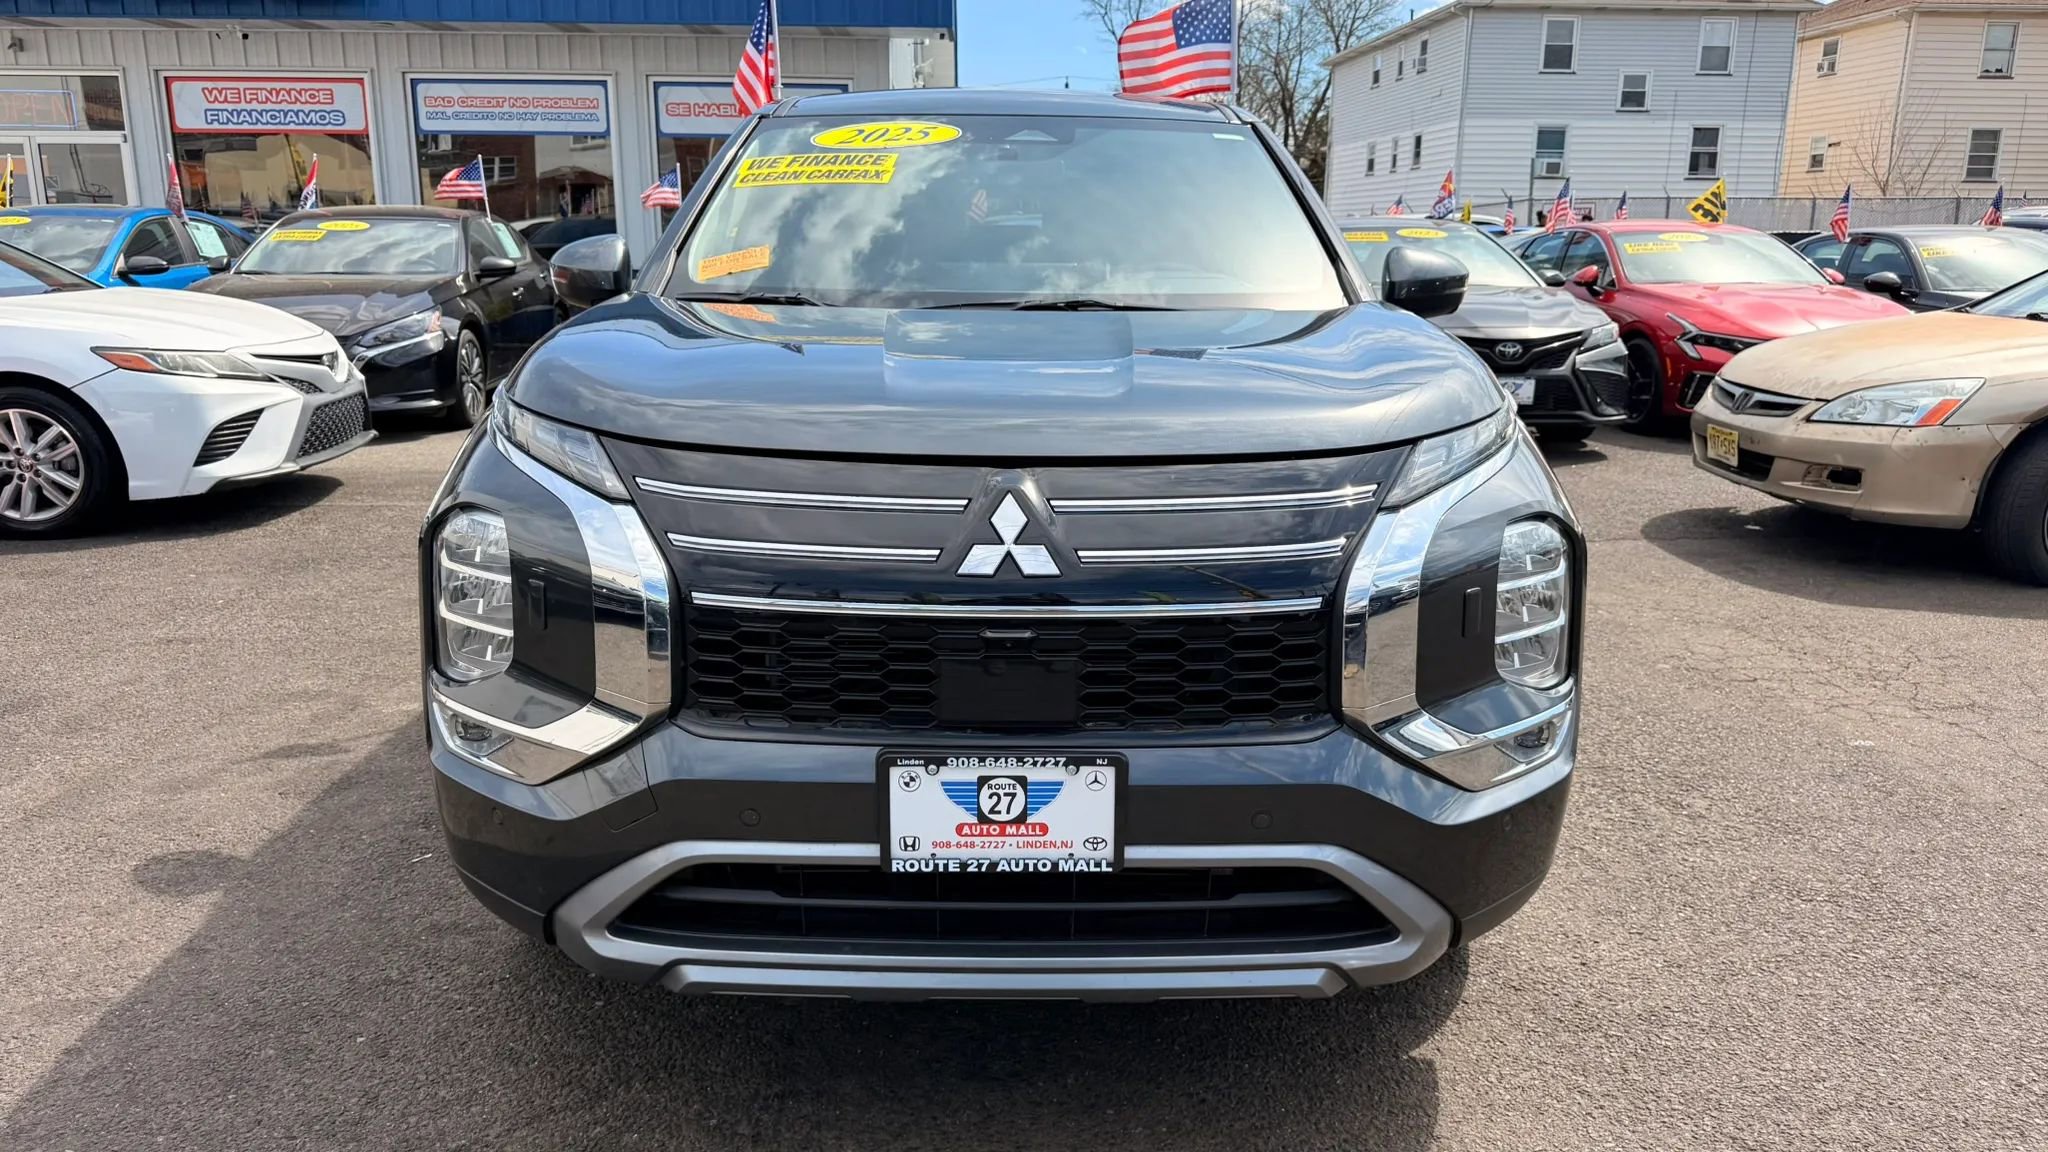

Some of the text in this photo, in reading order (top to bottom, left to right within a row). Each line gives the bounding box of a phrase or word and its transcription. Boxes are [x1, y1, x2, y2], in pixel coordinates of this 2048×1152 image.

[203, 87, 334, 104] WE FINANCE
[425, 97, 598, 109] BAD CREDIT NO PROBLEM
[666, 103, 742, 117] SE HABL
[205, 108, 345, 126] FINANCIAMOS
[426, 111, 599, 123] MAL CREDITO NO HAY PROBLEMA
[837, 127, 930, 146] 2025
[747, 155, 888, 171] WE FINANCE
[739, 169, 889, 185] CLEAN CARFAX
[897, 758, 925, 766] Linden
[947, 757, 1067, 769] 908-648-2727
[987, 783, 1017, 791] ROUTE
[987, 792, 1017, 815] 27
[961, 824, 1043, 835] AUTO MALL
[931, 840, 1006, 849] 908-648-2727
[891, 858, 1113, 873] ROUTE 27 AUTO MALL
